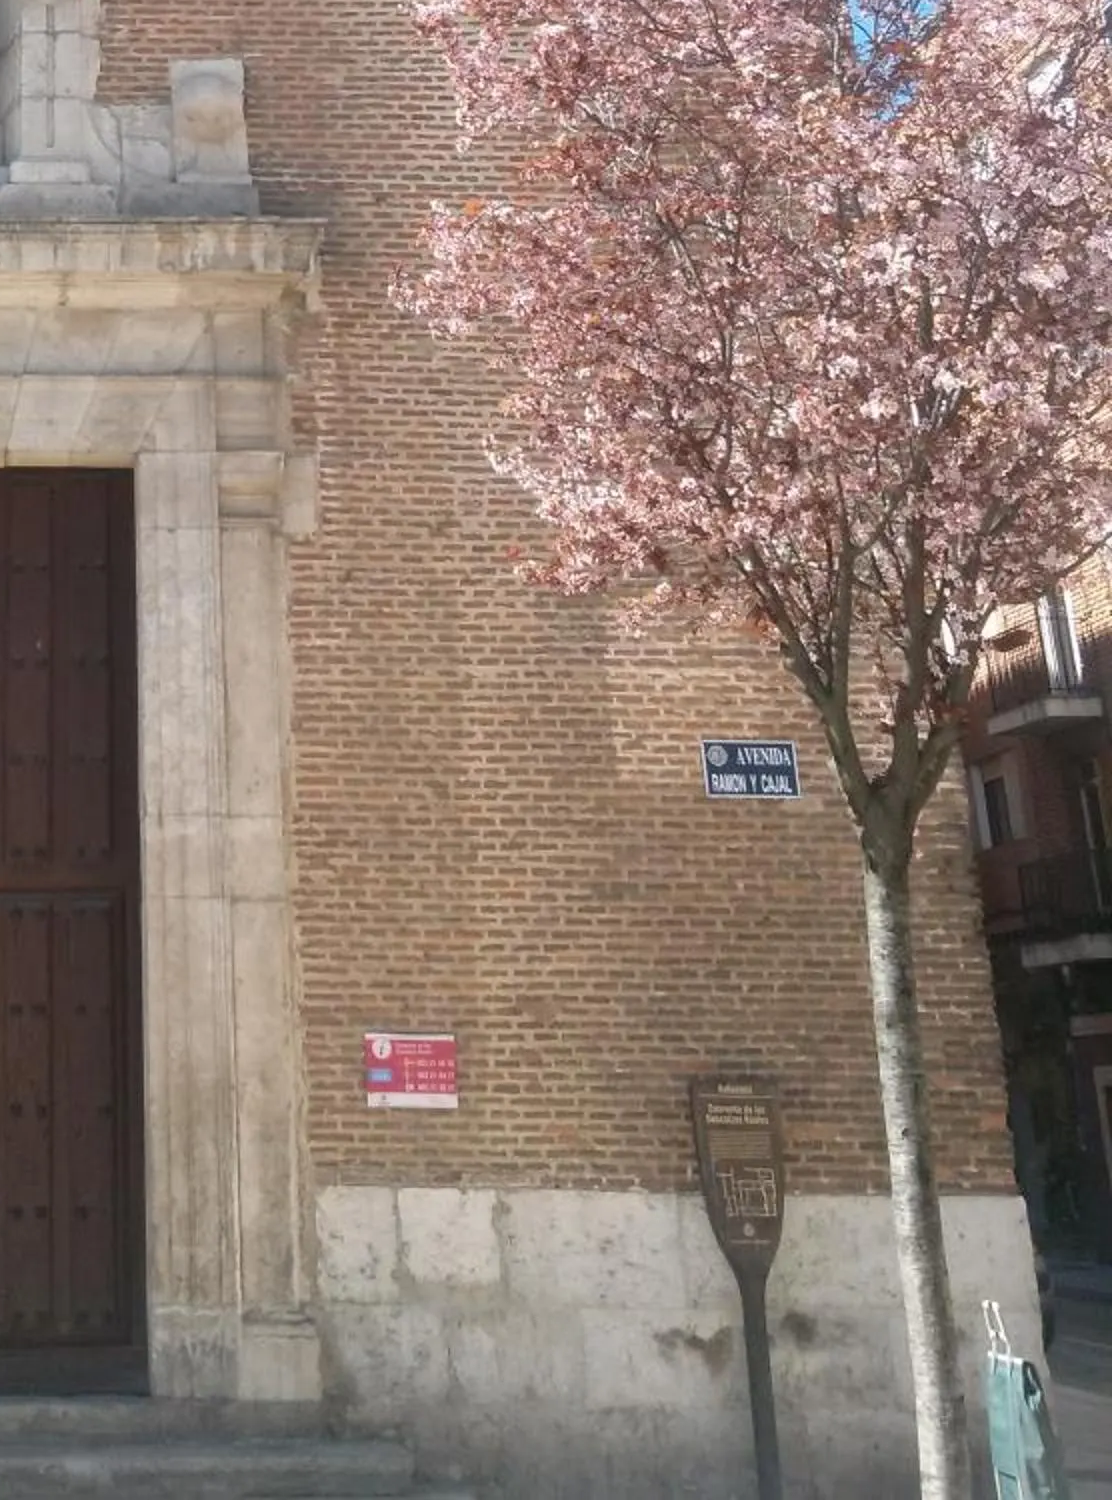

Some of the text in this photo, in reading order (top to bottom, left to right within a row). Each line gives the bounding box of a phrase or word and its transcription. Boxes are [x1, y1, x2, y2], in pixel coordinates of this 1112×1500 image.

[736, 747, 792, 766] AVENIDA
[749, 773, 757, 793] Y
[761, 773, 793, 793] CAJAL
